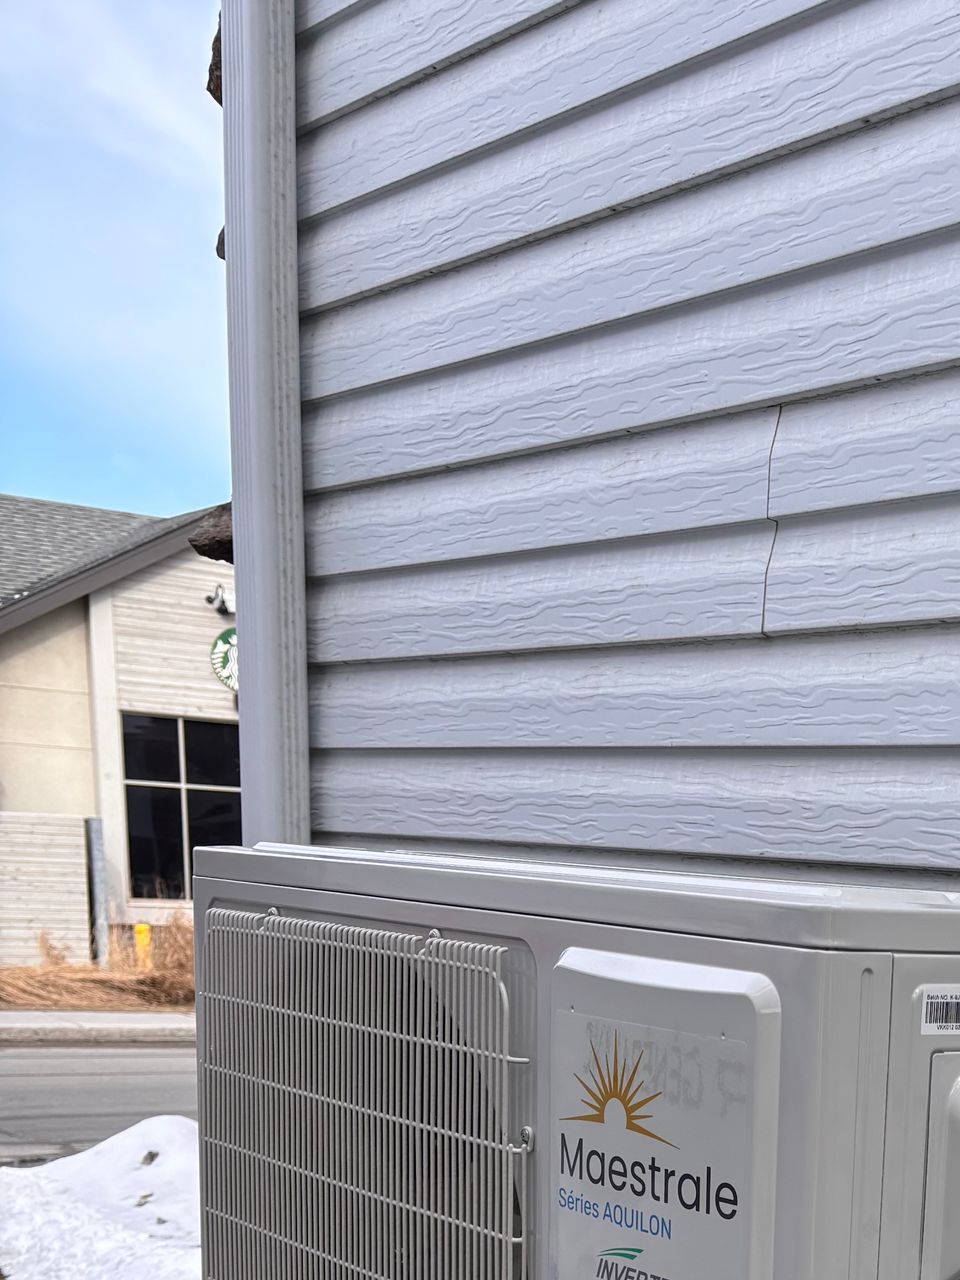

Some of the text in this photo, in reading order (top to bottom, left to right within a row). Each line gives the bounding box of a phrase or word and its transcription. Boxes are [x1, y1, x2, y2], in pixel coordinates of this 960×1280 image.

[560, 1132, 738, 1221] Maestrale
[558, 1188, 672, 1241] Séries AQUILON
